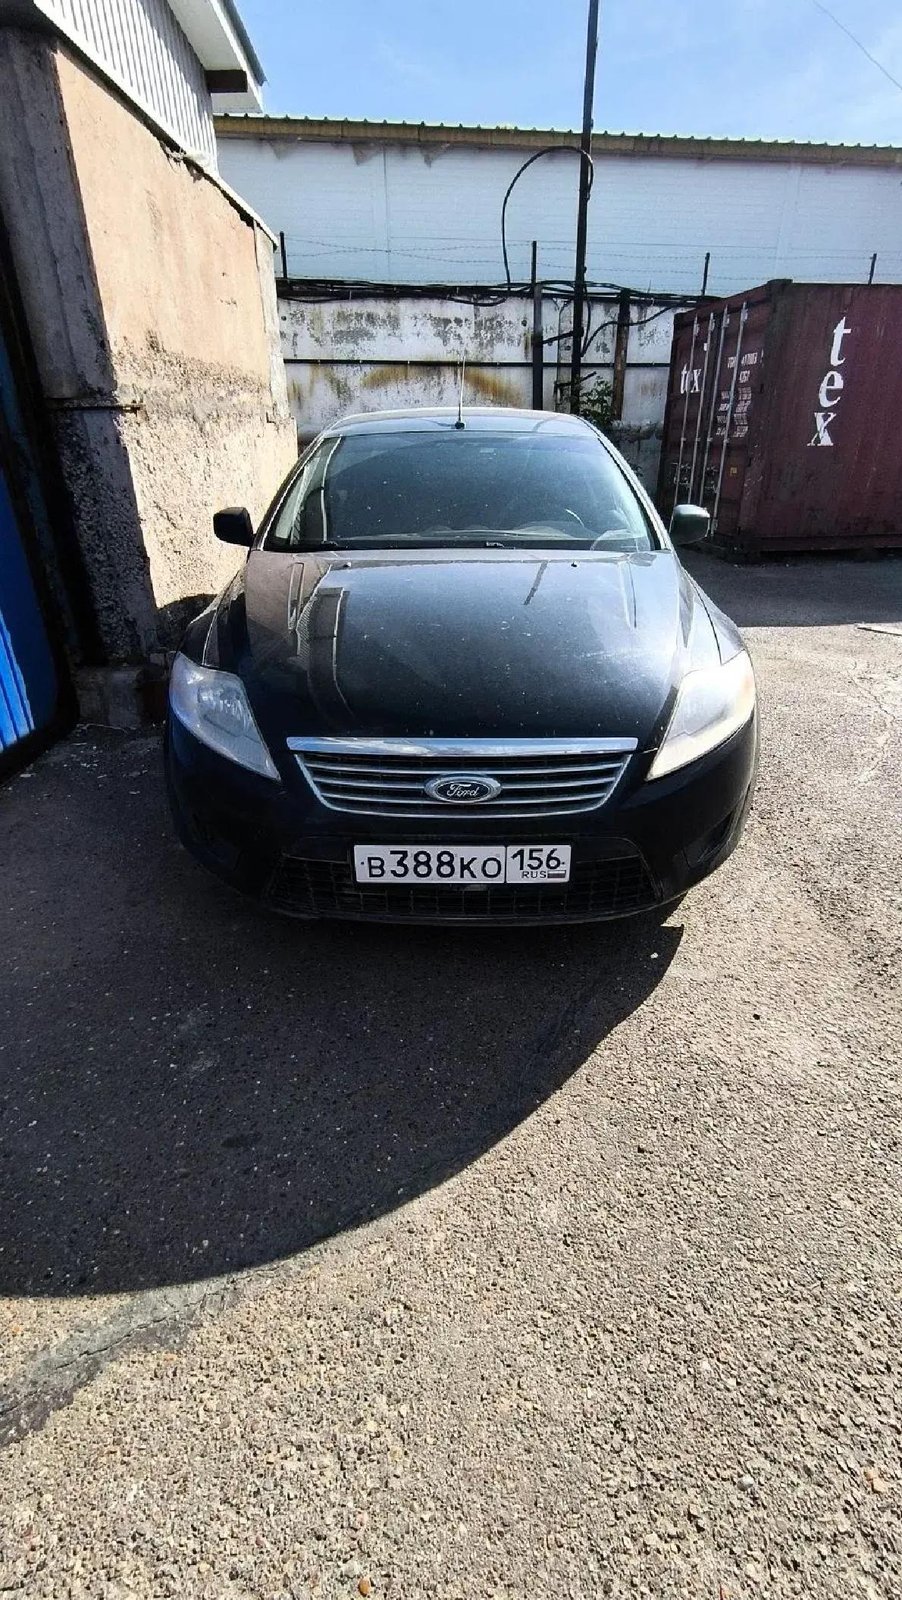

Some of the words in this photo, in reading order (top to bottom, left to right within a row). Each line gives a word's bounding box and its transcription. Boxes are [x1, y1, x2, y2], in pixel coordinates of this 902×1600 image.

[807, 316, 851, 446] tex
[447, 783, 480, 797] Ford
[511, 848, 561, 871] 156
[521, 870, 547, 879] RUS
